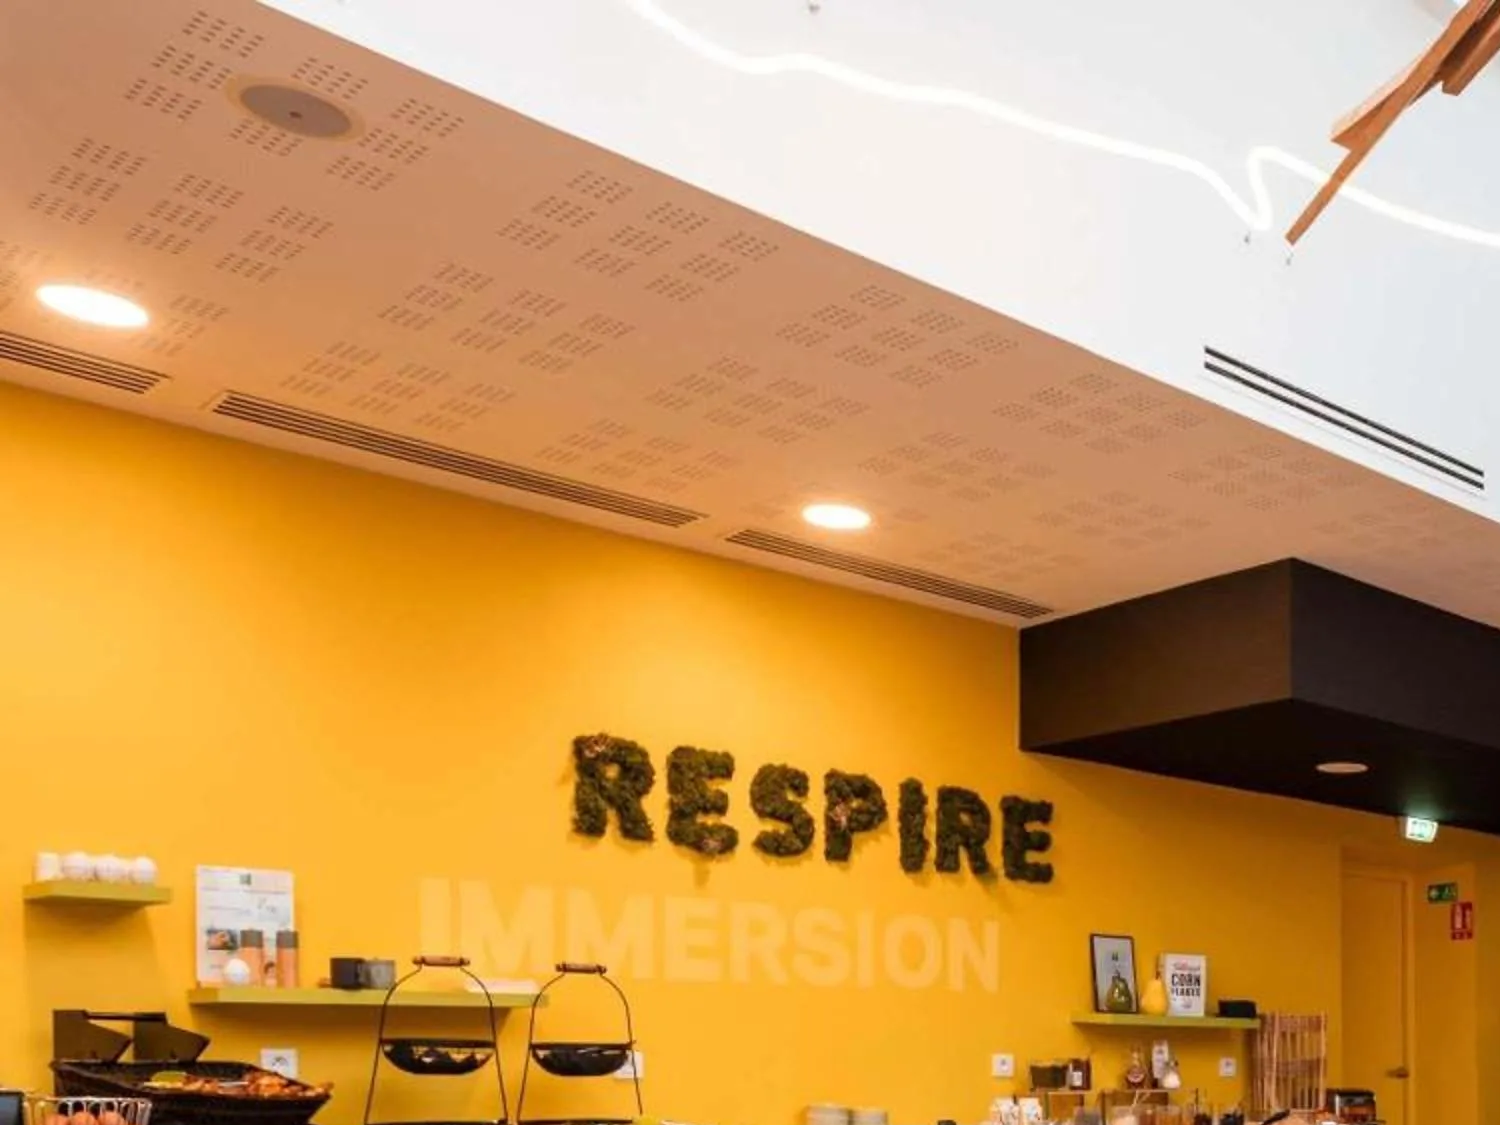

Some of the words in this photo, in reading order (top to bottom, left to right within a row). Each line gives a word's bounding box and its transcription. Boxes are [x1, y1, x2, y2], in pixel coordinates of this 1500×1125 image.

[572, 733, 1054, 883] RESPIRE
[416, 877, 1001, 993] IMMERSION
[1171, 973, 1201, 987] CORN
